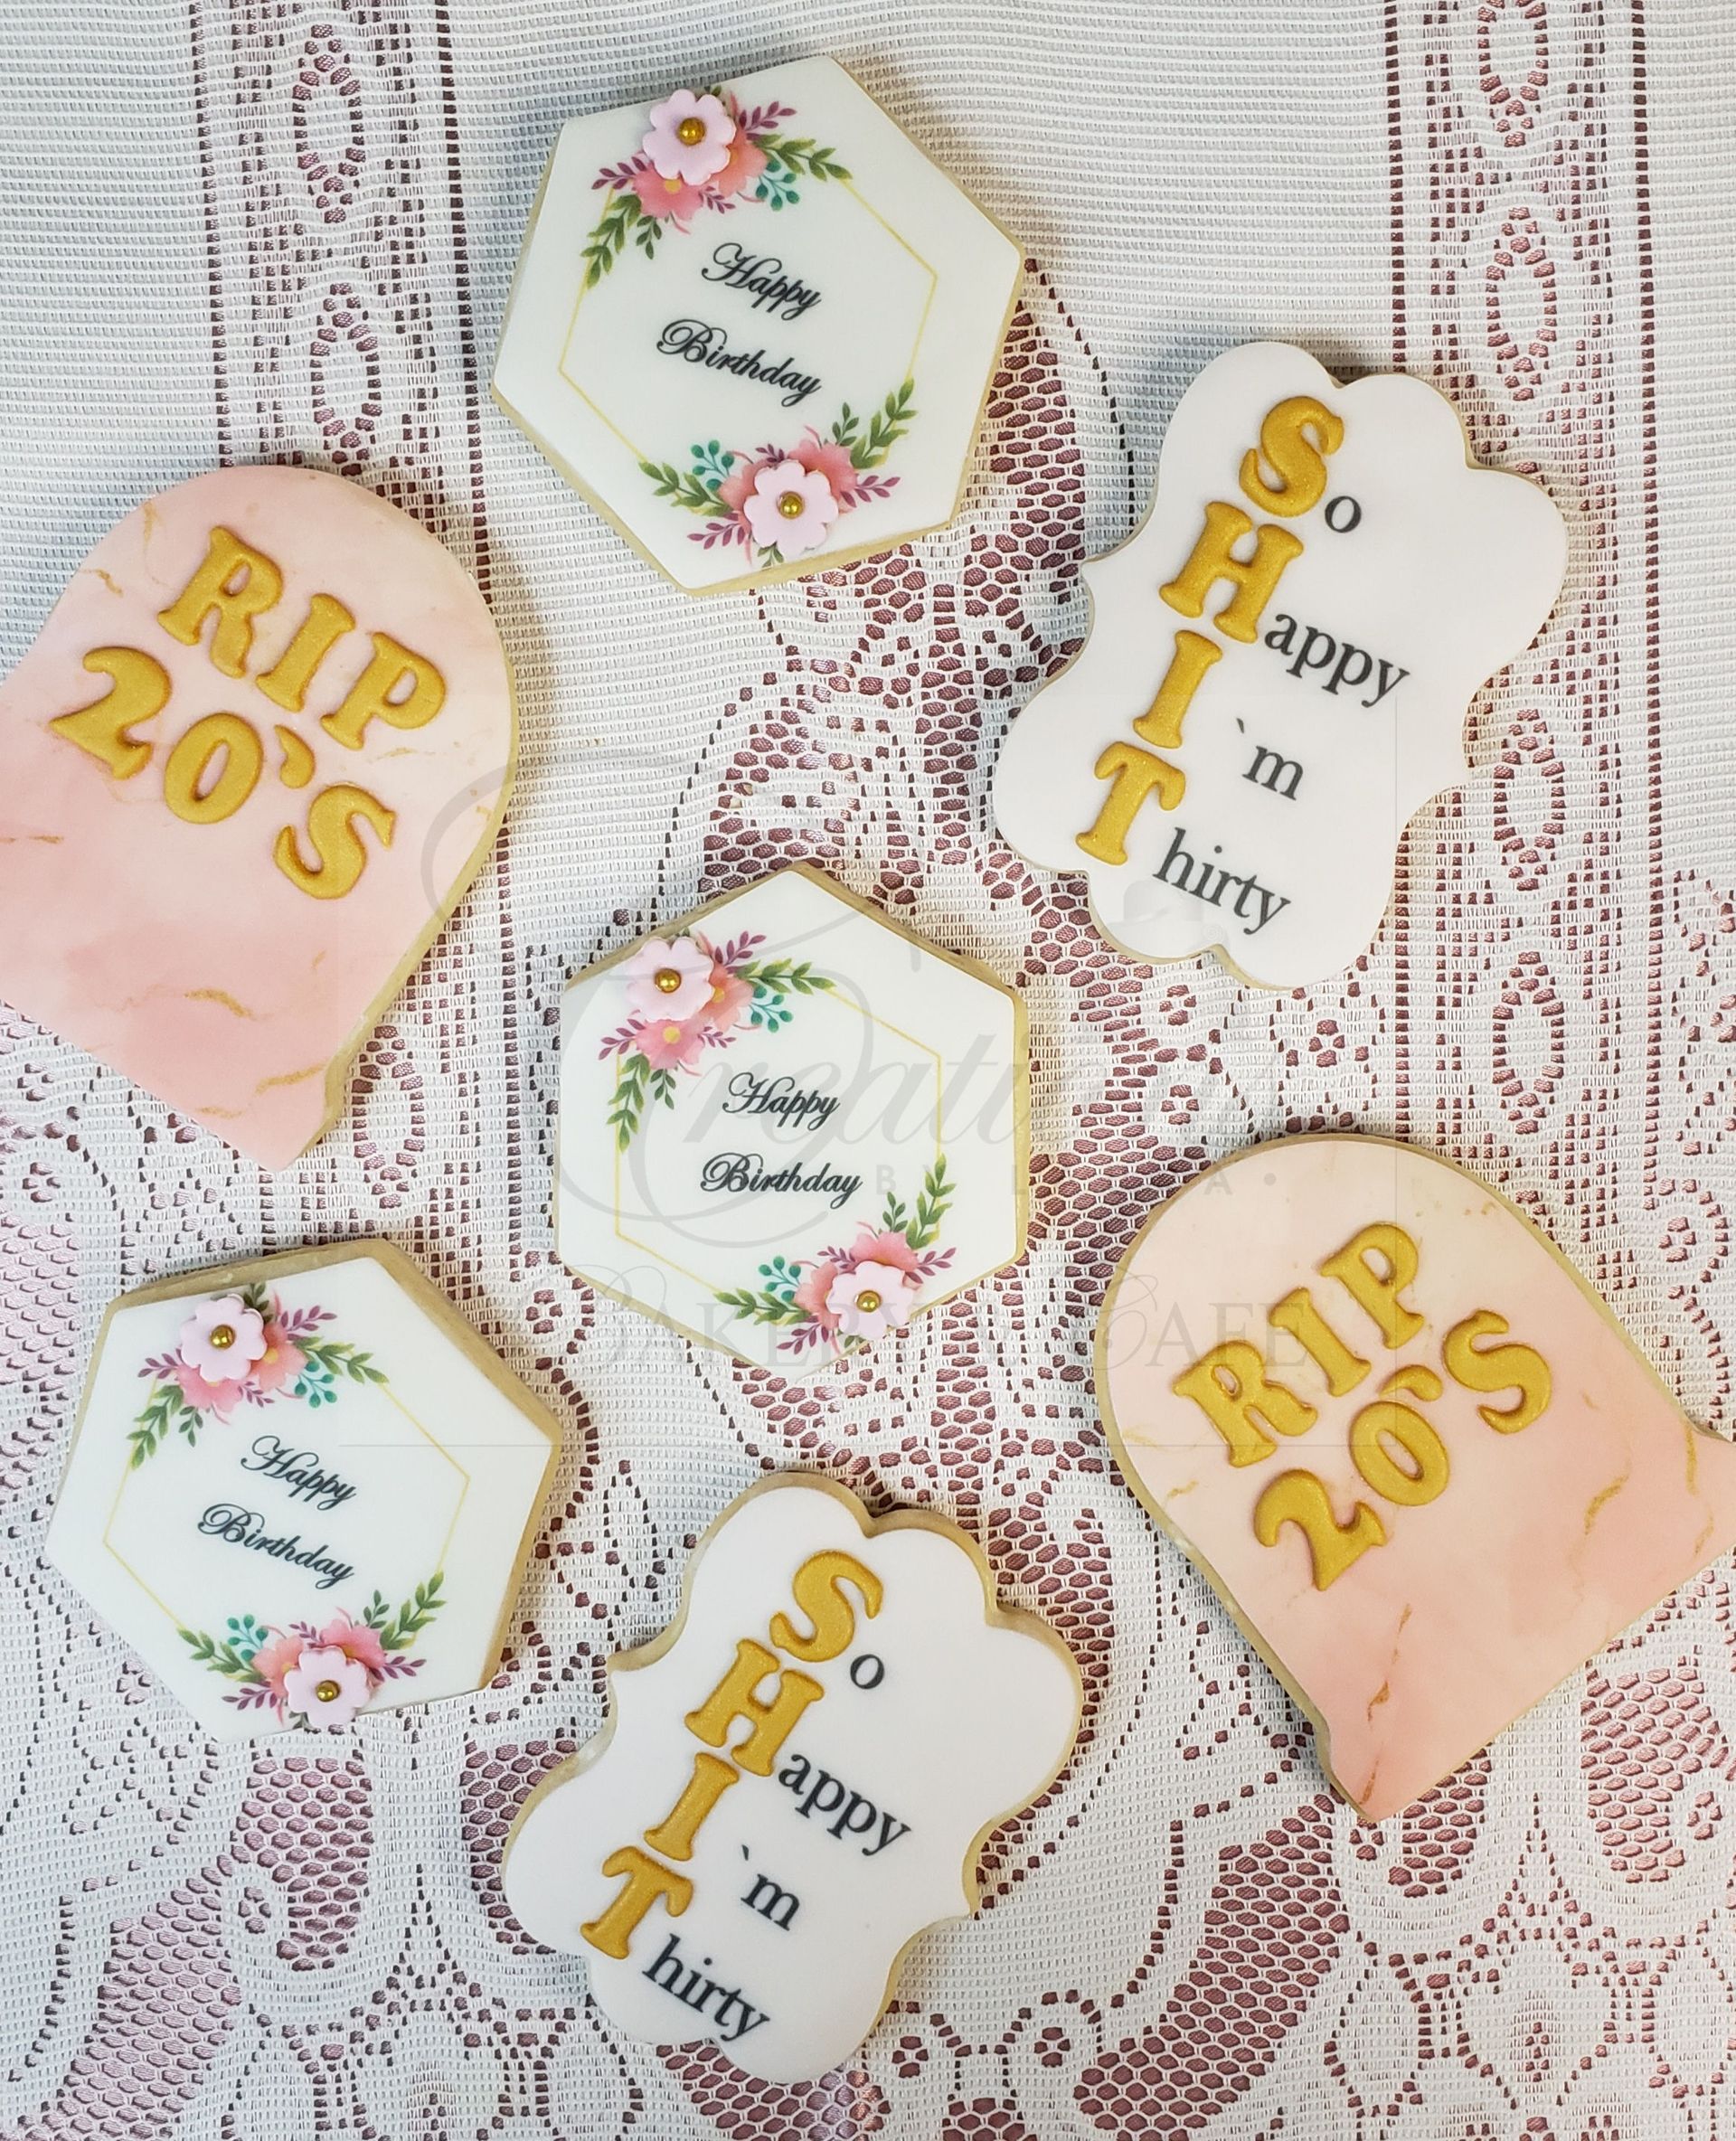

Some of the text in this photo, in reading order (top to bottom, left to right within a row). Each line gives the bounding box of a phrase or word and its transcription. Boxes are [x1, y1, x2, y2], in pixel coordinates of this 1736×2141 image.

[701, 242, 822, 321] Happy
[656, 318, 822, 407] Birthday
[156, 524, 448, 750] RIP
[722, 1071, 840, 1131] Happy
[700, 1152, 863, 1210] Birthday
[1172, 1222, 1426, 1468] RIP
[240, 1435, 356, 1511] Happy
[197, 1503, 354, 1589] Birthday
